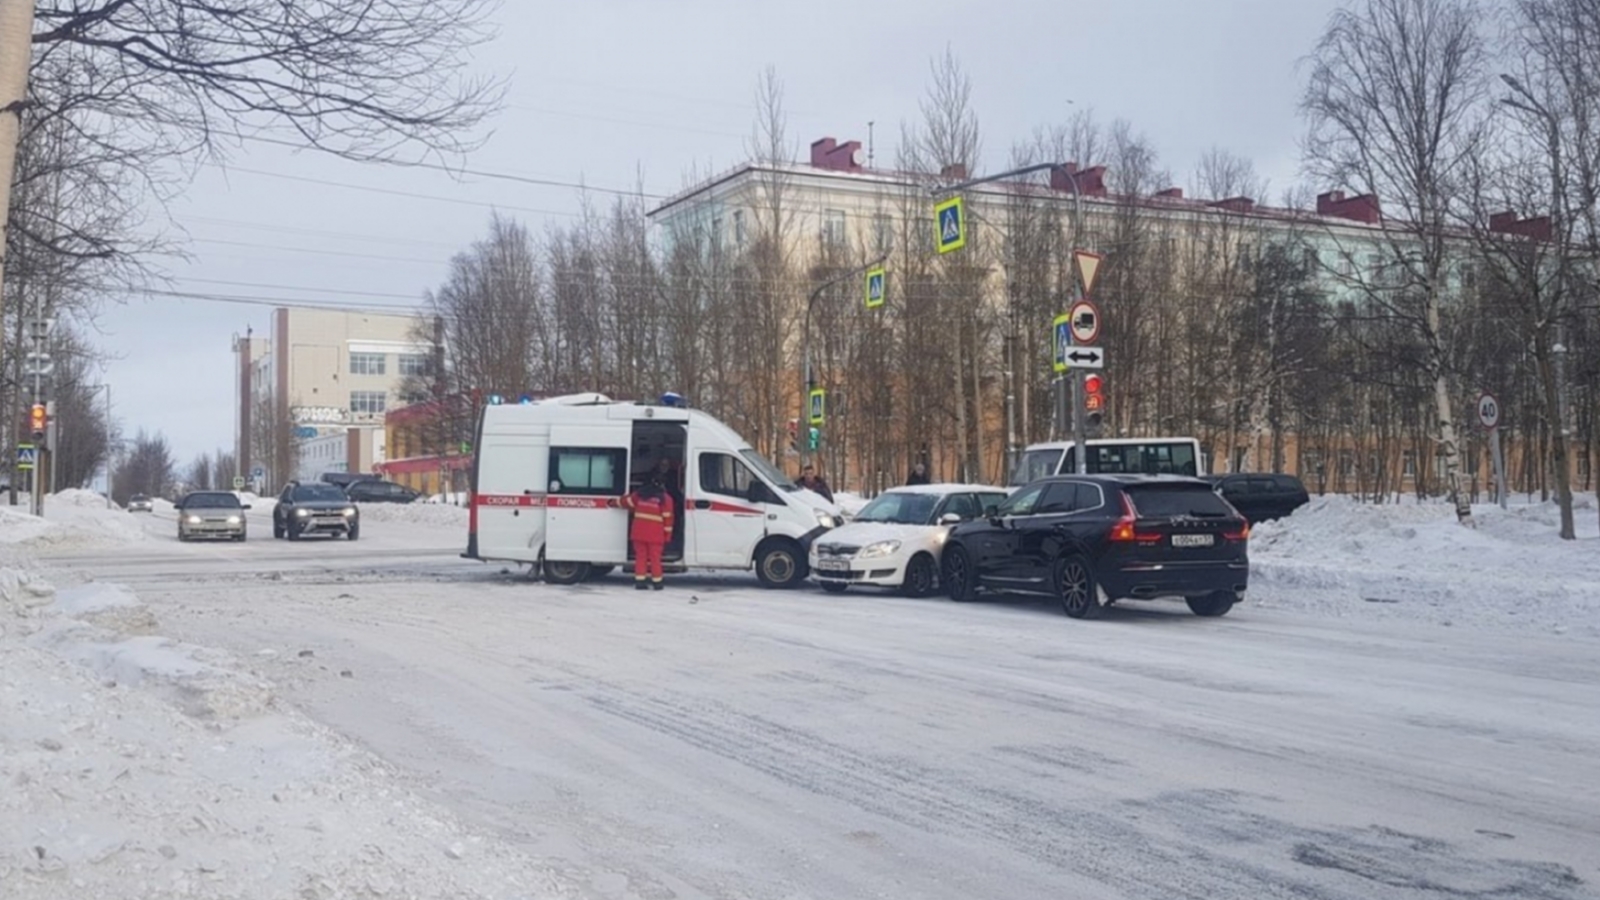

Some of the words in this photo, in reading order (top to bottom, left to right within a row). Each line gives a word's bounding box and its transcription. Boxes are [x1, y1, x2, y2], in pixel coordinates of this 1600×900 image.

[1482, 403, 1496, 417] 40
[486, 496, 520, 505] СКОРАЯ
[556, 498, 597, 507] ПОМОЩЬ
